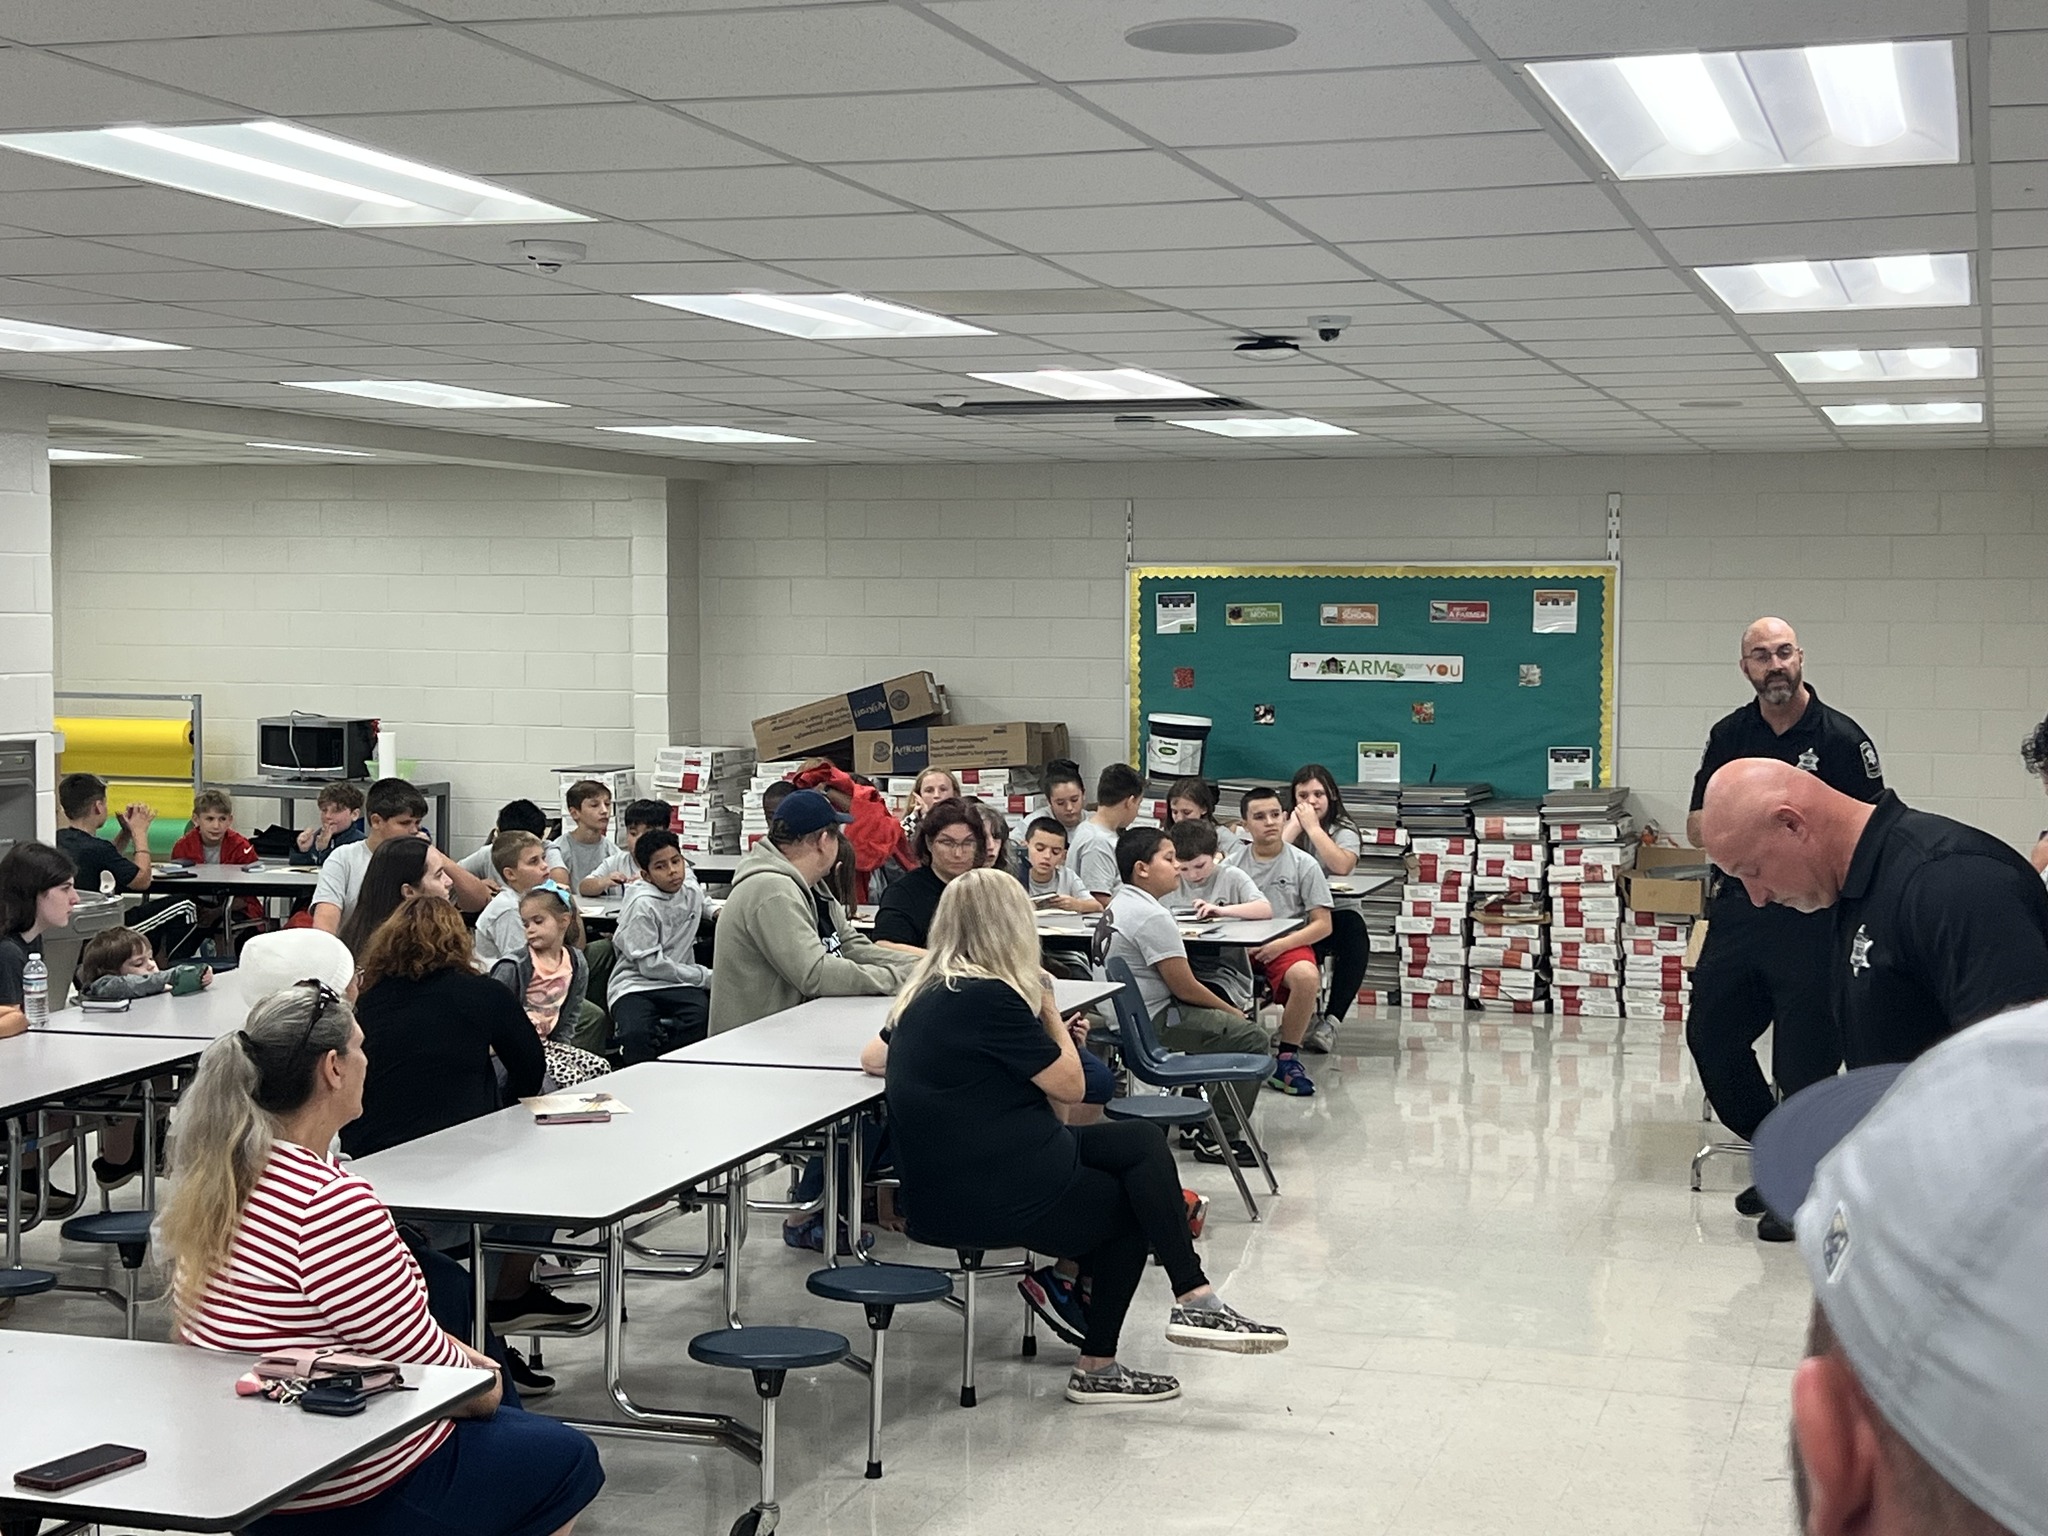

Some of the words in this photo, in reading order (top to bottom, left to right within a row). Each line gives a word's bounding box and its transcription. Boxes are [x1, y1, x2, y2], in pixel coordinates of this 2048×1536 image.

[1338, 660, 1391, 675] FARM
[1426, 663, 1460, 677] YOU
[853, 701, 887, 718] ArtKraft
[894, 744, 927, 756] ArtKraft
